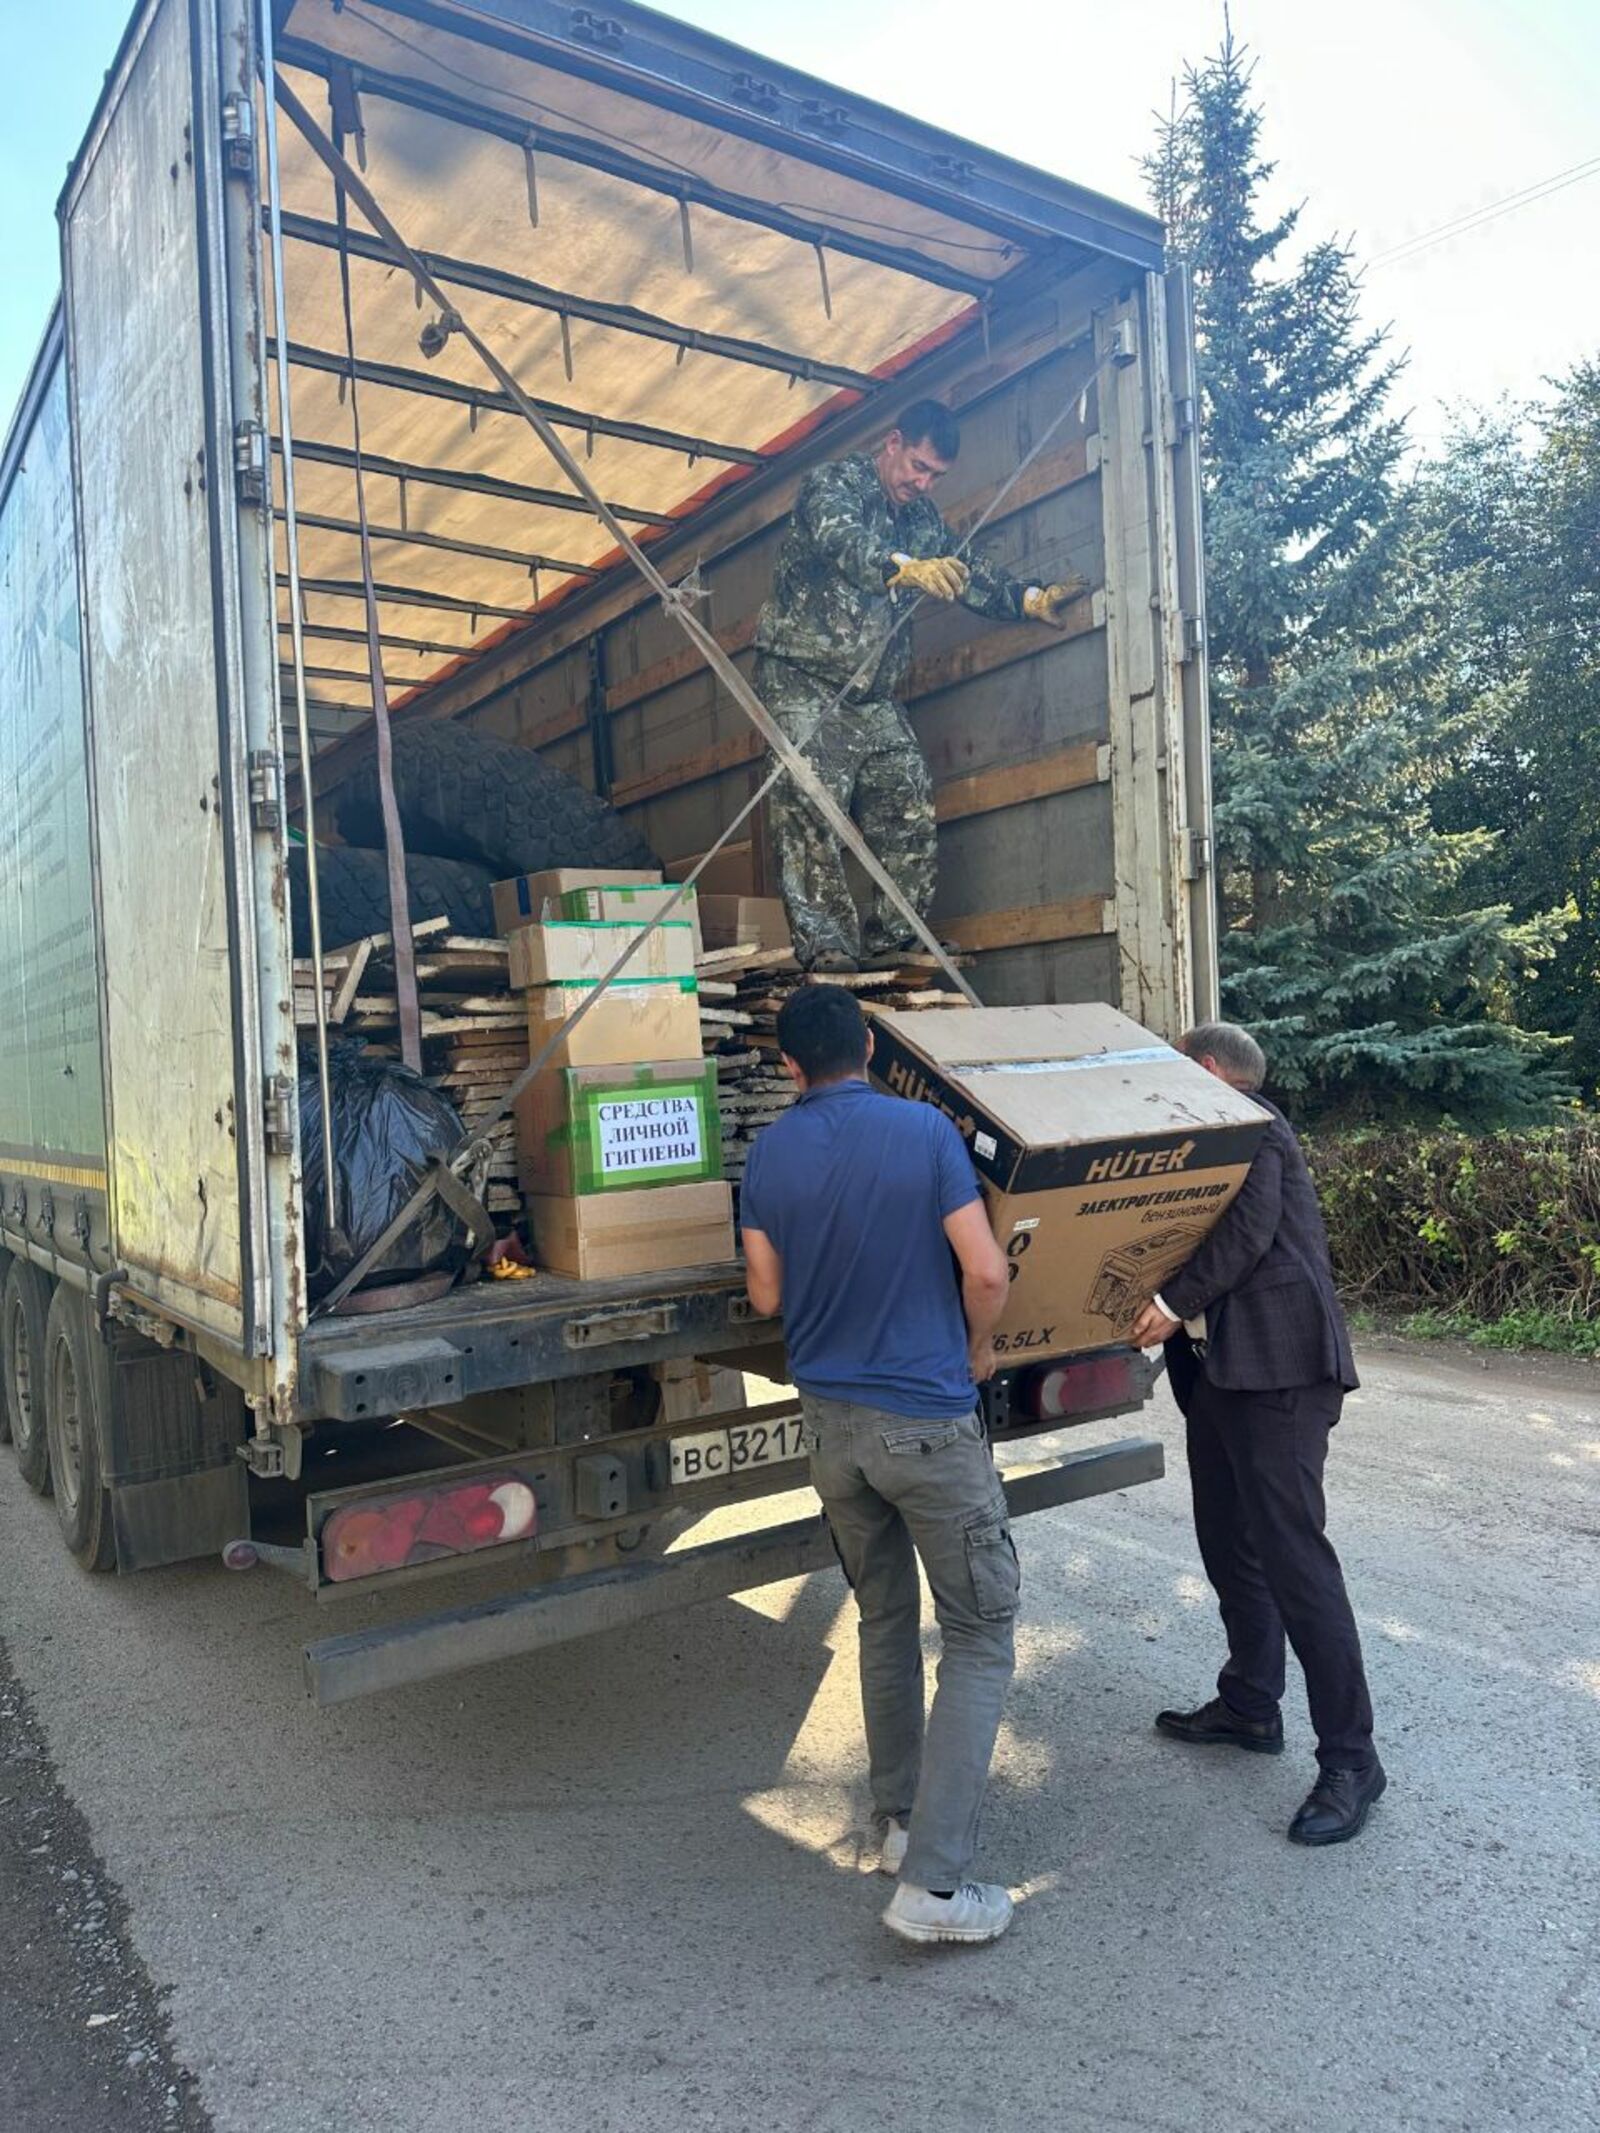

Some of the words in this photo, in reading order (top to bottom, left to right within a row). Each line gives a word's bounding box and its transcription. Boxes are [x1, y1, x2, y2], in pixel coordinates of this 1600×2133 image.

[599, 1099, 695, 1121] СРЕДСТВА
[608, 1117, 689, 1144] ЛИЧНОЙ
[605, 1142, 696, 1167] ГИГИЕНЫ
[1085, 1139, 1196, 1181] HÜTER
[1075, 1183, 1230, 1216] ЭЛЕКТРОГЕНЕРАТОР
[992, 1326, 1056, 1351] 6,5LX
